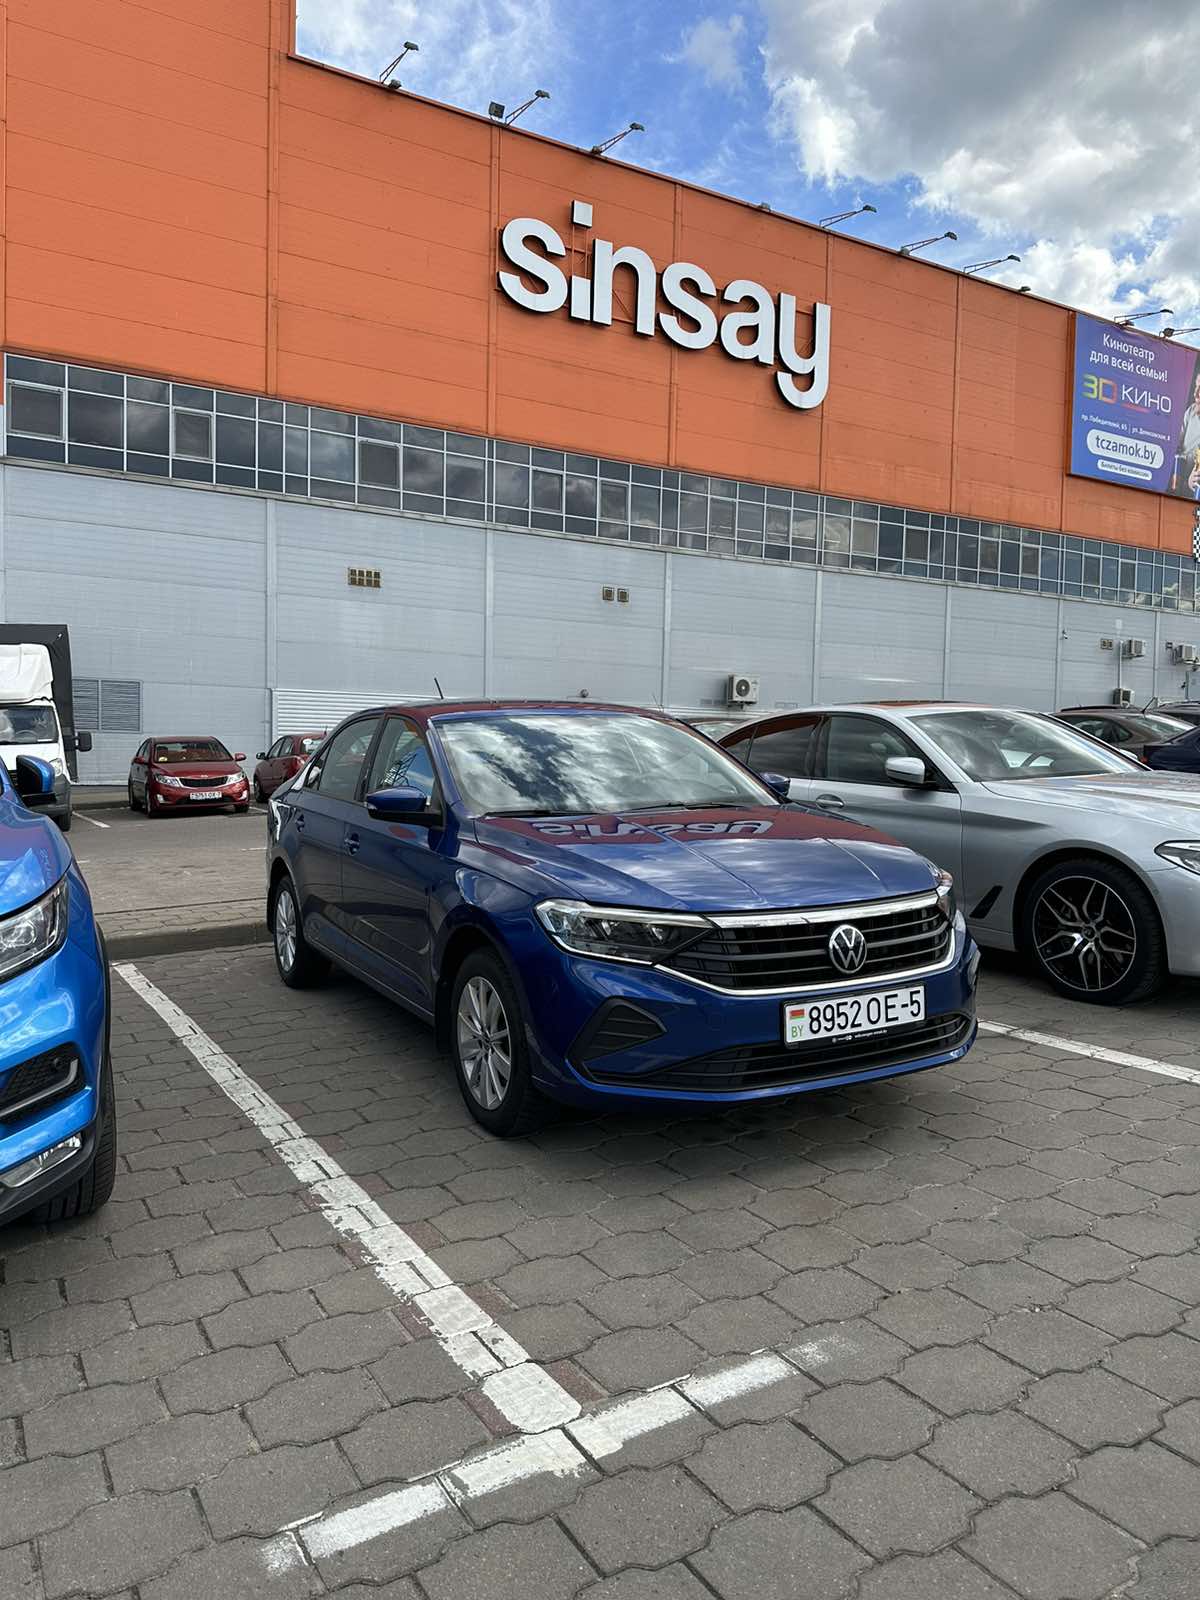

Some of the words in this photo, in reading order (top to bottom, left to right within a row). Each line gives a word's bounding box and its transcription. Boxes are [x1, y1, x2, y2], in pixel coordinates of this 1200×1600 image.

[498, 199, 831, 410] sinsay
[1103, 333, 1155, 363] Кинотеатр
[1089, 350, 1109, 366] для
[1111, 356, 1134, 373] всей
[1135, 364, 1168, 382] семьи!
[1082, 372, 1118, 404] 3D
[1121, 384, 1172, 413] КИНО
[1096, 435, 1157, 464] tczamok.by
[791, 1024, 805, 1038] BY
